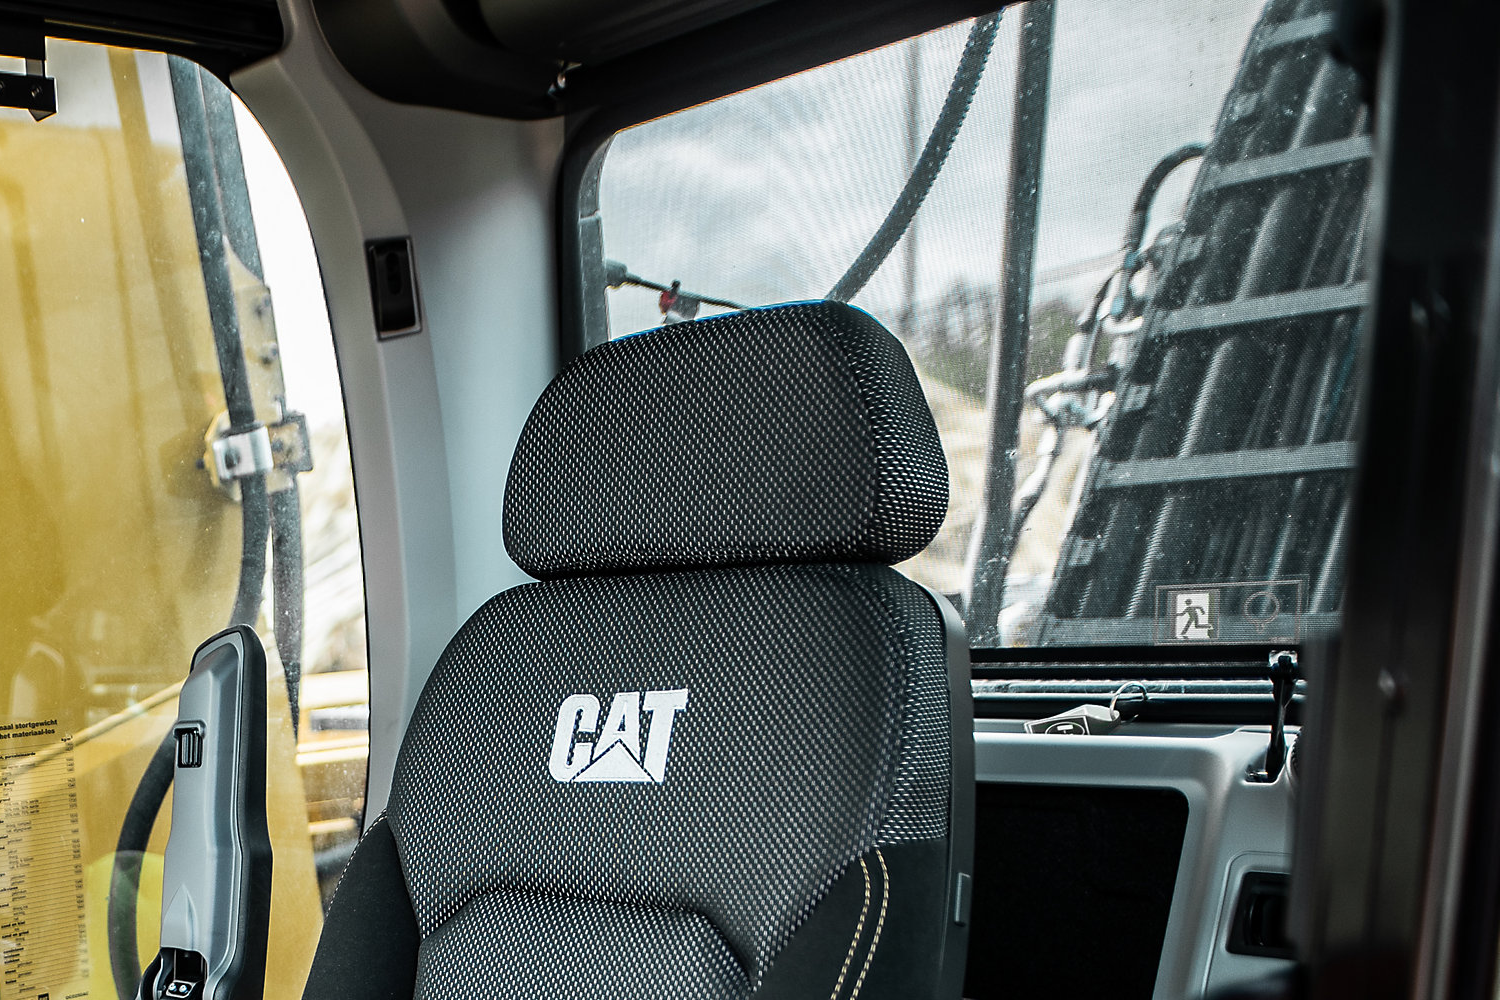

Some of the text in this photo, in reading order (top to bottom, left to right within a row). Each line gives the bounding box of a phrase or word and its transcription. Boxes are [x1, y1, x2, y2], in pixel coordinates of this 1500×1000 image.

[15, 719, 58, 730] stortgewicht
[0, 732, 11, 740] het
[549, 688, 689, 783] CAT
